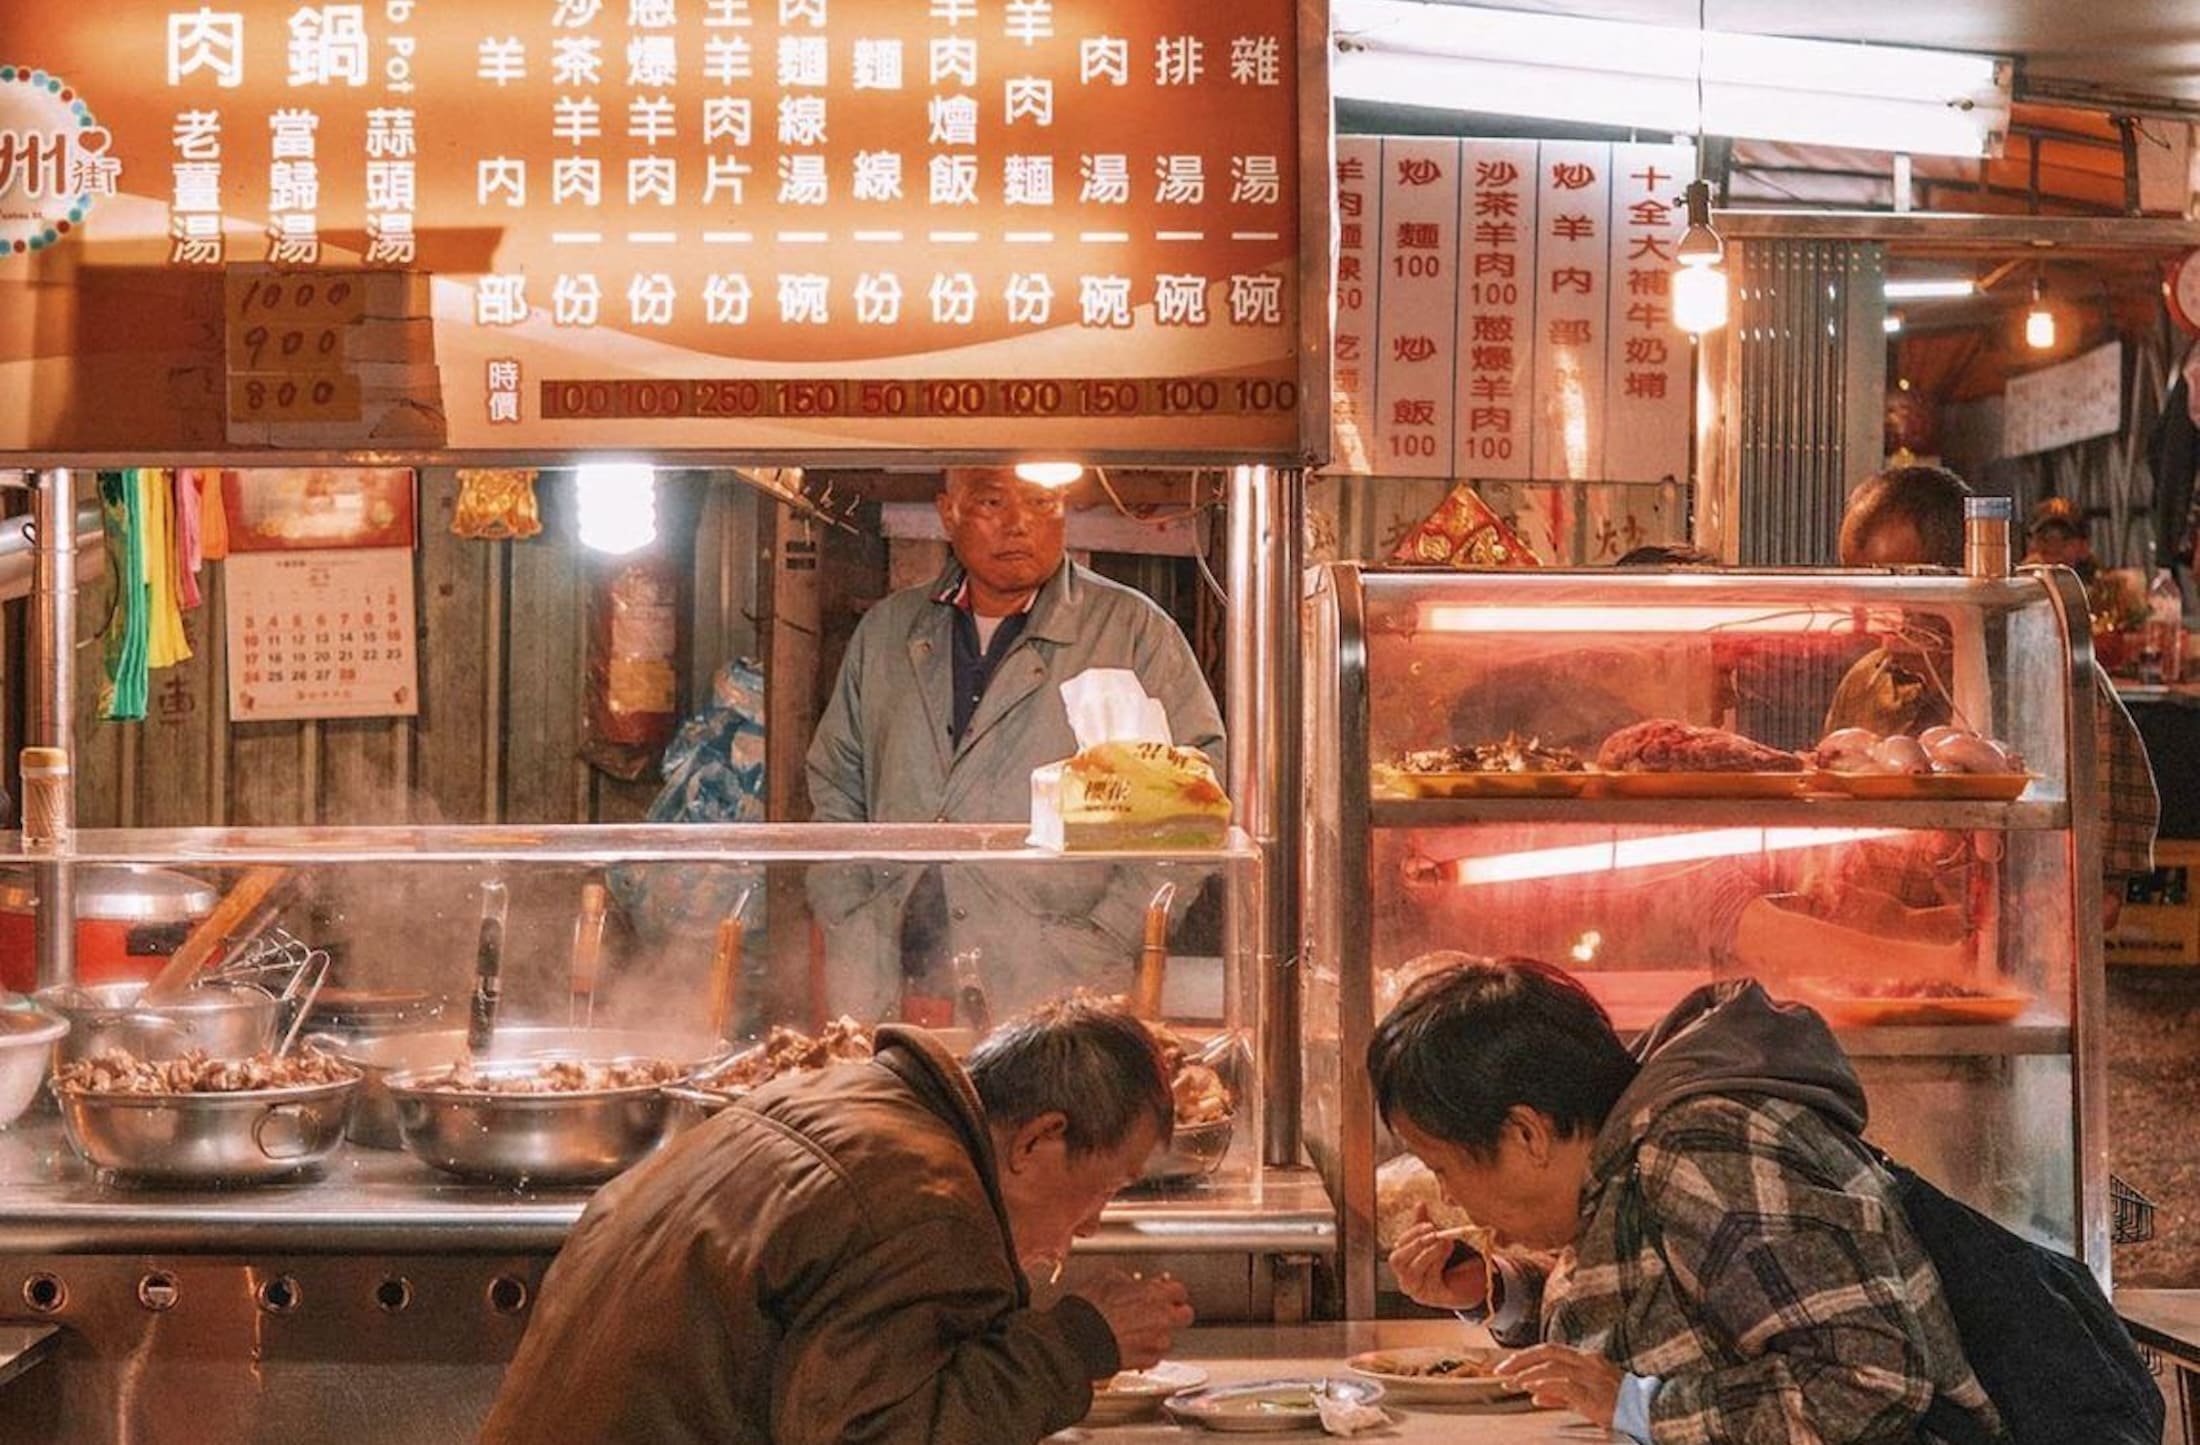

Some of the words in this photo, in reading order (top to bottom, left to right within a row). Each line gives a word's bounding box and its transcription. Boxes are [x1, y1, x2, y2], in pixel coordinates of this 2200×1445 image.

[166, 4, 370, 87] 肉鍋
[385, 36, 416, 93] Pot
[171, 108, 223, 264] 老薑湯
[268, 108, 321, 264] 當歸湯
[365, 107, 416, 264] 蒜頭湯
[477, 37, 527, 325] 羊內部
[552, 0, 602, 325] 沙茶羊肉一份
[853, 38, 903, 325] 麵線一份
[1004, 0, 1055, 325] 羊肉麵一份
[1079, 36, 1131, 327] 肉湯一碗
[1154, 36, 1206, 325] 排湯一碗
[1230, 36, 1282, 325] 雜湯一碗
[1396, 158, 1442, 251] 炒麵
[1474, 160, 1519, 279] 沙茶羊肉
[1392, 255, 1440, 278] 100
[1470, 282, 1517, 306] 100
[244, 326, 337, 369] 900
[487, 360, 519, 422] 時價
[1392, 335, 1438, 427] 炒飯
[245, 381, 335, 410] 800
[621, 384, 682, 414] 100
[696, 383, 760, 413] 250
[777, 383, 838, 413] 150
[861, 382, 903, 413] 50
[922, 381, 986, 413] 100
[1001, 381, 1062, 413] 100
[1080, 381, 1139, 413] 150
[1156, 381, 1219, 412] 100
[1236, 380, 1296, 411] 100
[1389, 434, 1436, 458] 100
[1466, 437, 1512, 460] 100
